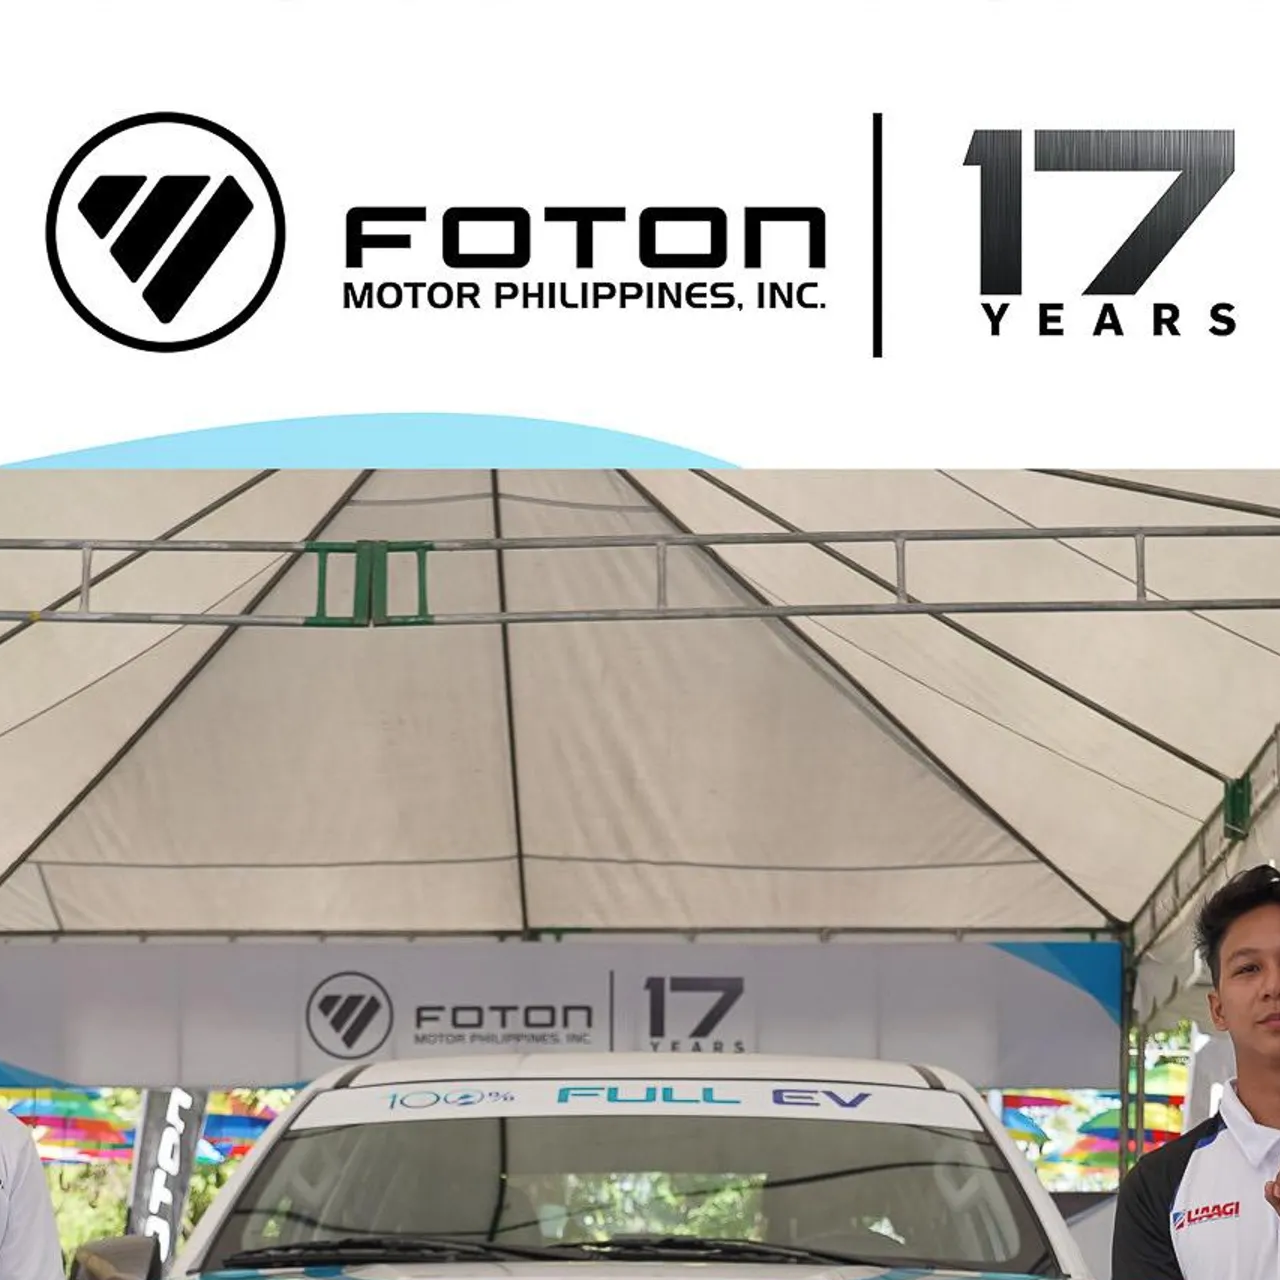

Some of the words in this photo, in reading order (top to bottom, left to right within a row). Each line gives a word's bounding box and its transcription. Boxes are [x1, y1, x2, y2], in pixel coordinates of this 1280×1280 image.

[415, 1005, 593, 1029] FOTON
[644, 976, 744, 1039] 17
[649, 1041, 745, 1053] YEARS
[556, 1086, 742, 1105] FULL
[772, 1088, 873, 1109] EV
